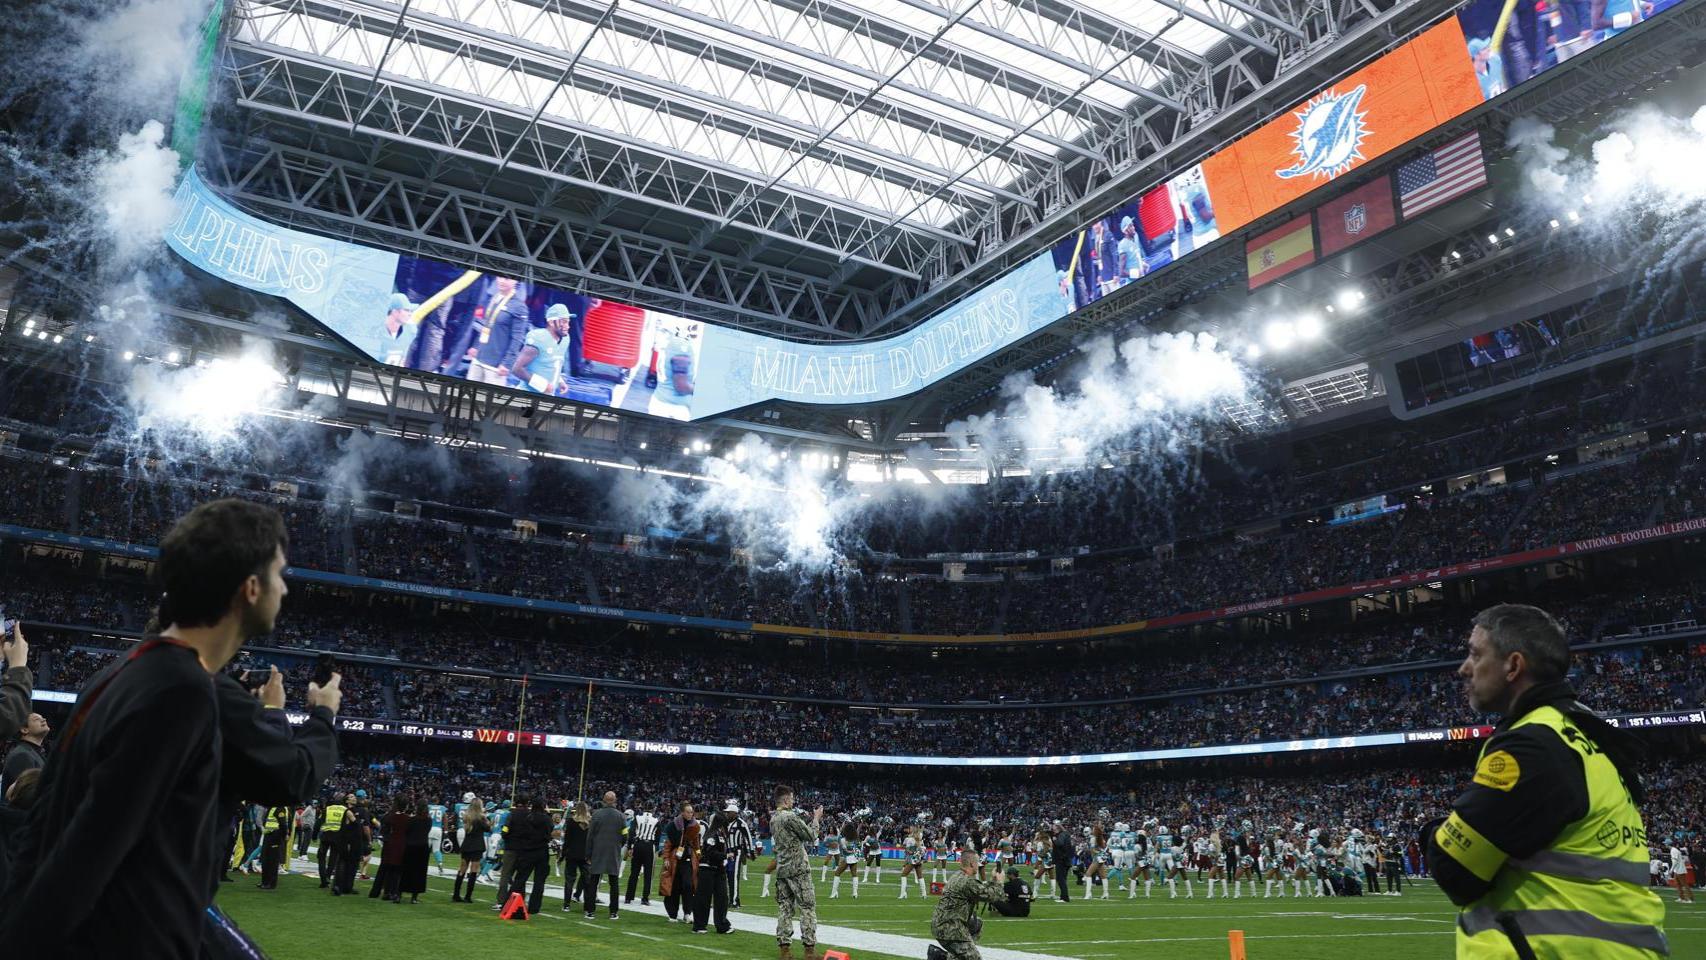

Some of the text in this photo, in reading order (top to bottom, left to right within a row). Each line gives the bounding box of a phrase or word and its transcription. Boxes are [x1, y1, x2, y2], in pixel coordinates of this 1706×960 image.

[750, 288, 1020, 396] MIAMI DOLPHINS
[1575, 535, 1620, 551] NATIONAL
[1620, 526, 1669, 543] FOOTBALL
[1629, 717, 1644, 727] 1ST
[1650, 716, 1661, 725] 10
[1689, 713, 1702, 722] 35
[343, 720, 364, 730] 9:23
[401, 725, 418, 735] 1ST
[423, 727, 434, 736] 10
[461, 730, 474, 739] 35
[507, 732, 515, 743] 0
[1416, 731, 1444, 740] NetApp
[1473, 728, 1480, 738] 0
[614, 740, 627, 751] 25
[646, 742, 680, 755] NetApp
